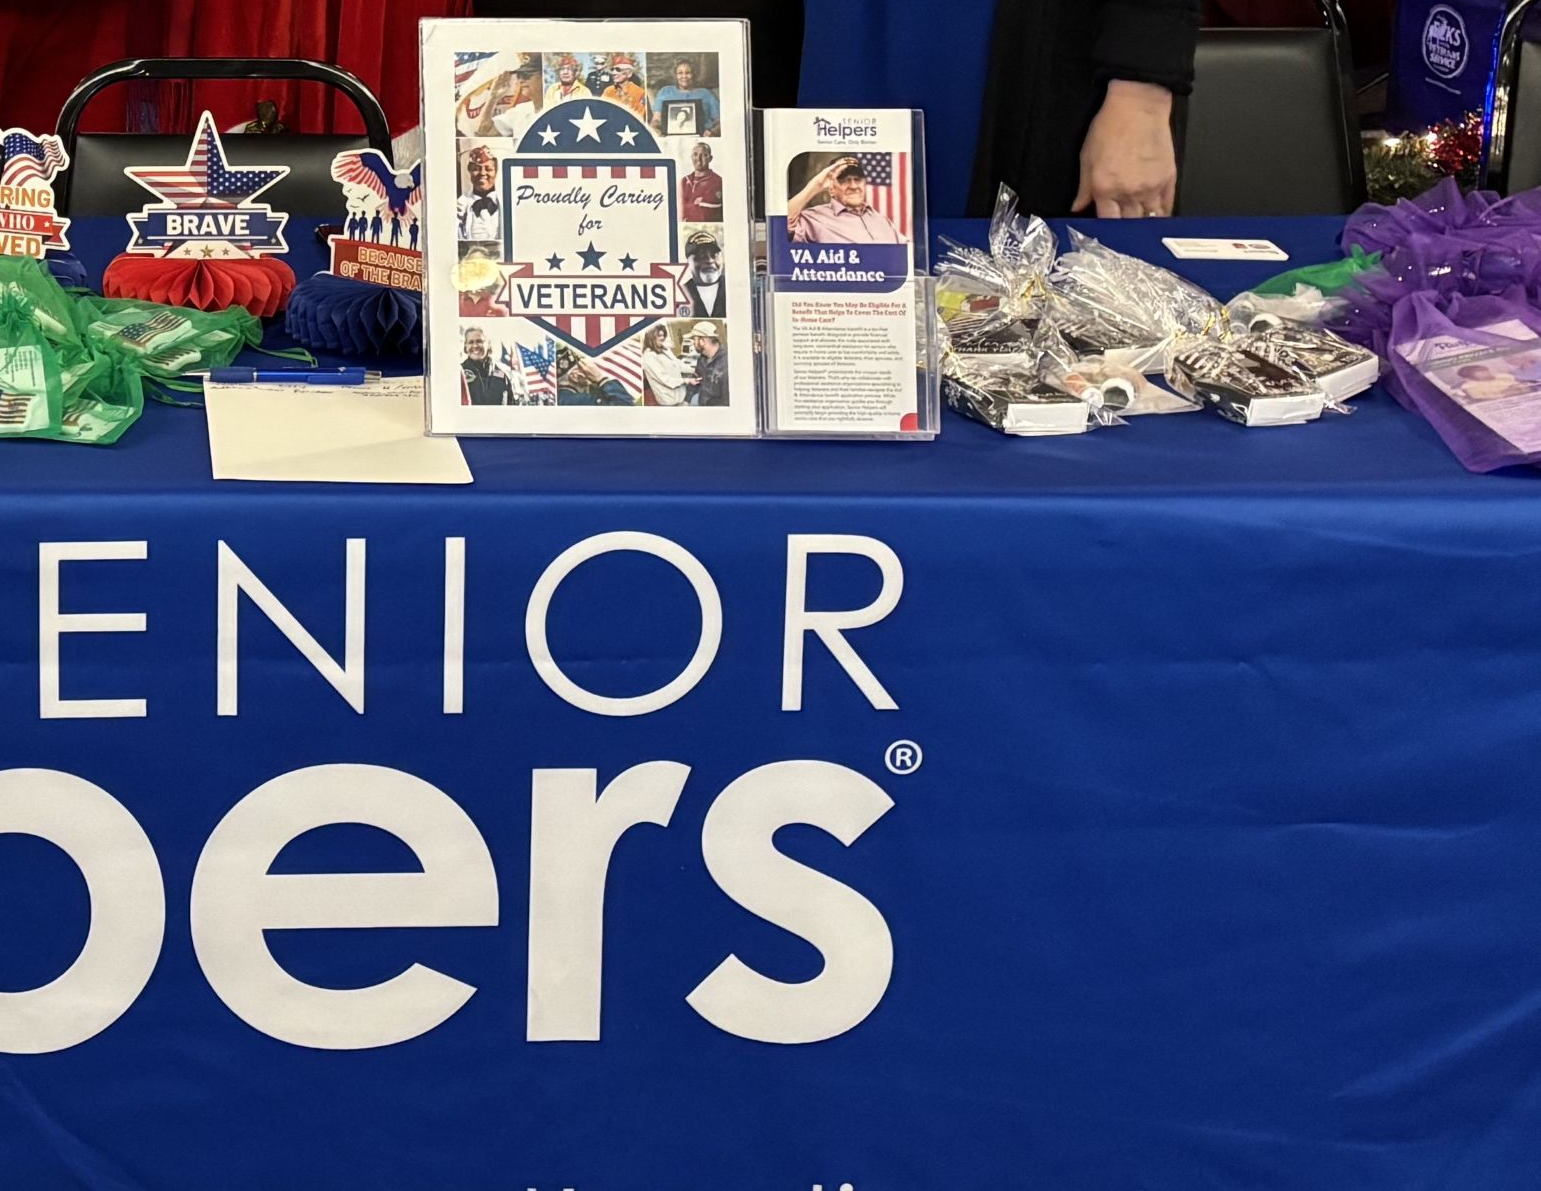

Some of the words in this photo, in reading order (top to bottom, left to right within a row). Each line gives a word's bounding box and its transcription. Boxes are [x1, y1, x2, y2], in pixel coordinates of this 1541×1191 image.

[817, 122, 877, 139] Helpers
[516, 184, 592, 209] Proudly
[599, 184, 665, 210] Caring
[166, 214, 250, 236] BRAVE
[577, 213, 603, 236] for
[358, 247, 423, 271] BECAUSE
[790, 249, 813, 264] VA
[817, 249, 845, 264] Aid
[848, 249, 860, 264] &
[340, 260, 360, 277] OF
[362, 265, 390, 285] THE
[390, 270, 423, 291] BRA
[791, 267, 885, 282] Attendance
[516, 283, 667, 310] VETERANS
